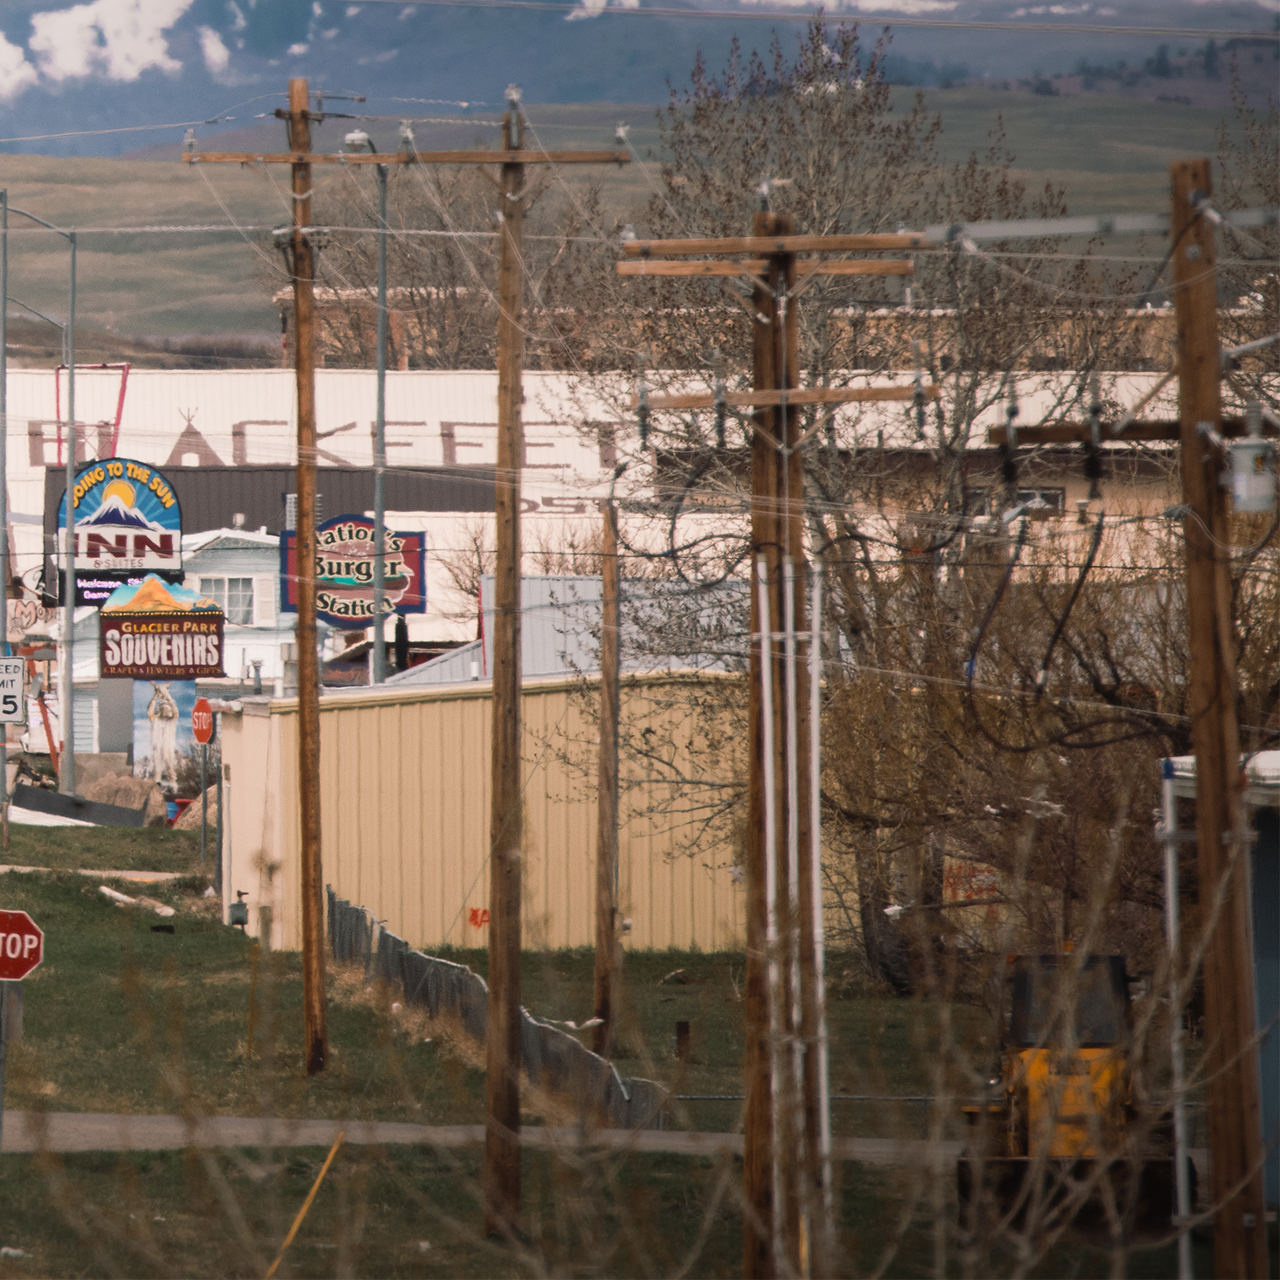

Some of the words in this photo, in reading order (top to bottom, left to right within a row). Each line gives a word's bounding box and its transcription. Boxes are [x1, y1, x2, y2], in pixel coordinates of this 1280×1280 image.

[73, 467, 105, 508] OING
[106, 462, 123, 477] TO
[126, 462, 151, 484] THE
[149, 477, 176, 509] SUN
[105, 559, 144, 568] SUITES
[121, 622, 180, 633] GLACIER
[183, 621, 218, 633] PARK
[105, 629, 220, 667] SOUVENIRS
[196, 666, 222, 675] GIFTS
[193, 711, 212, 730] STOP
